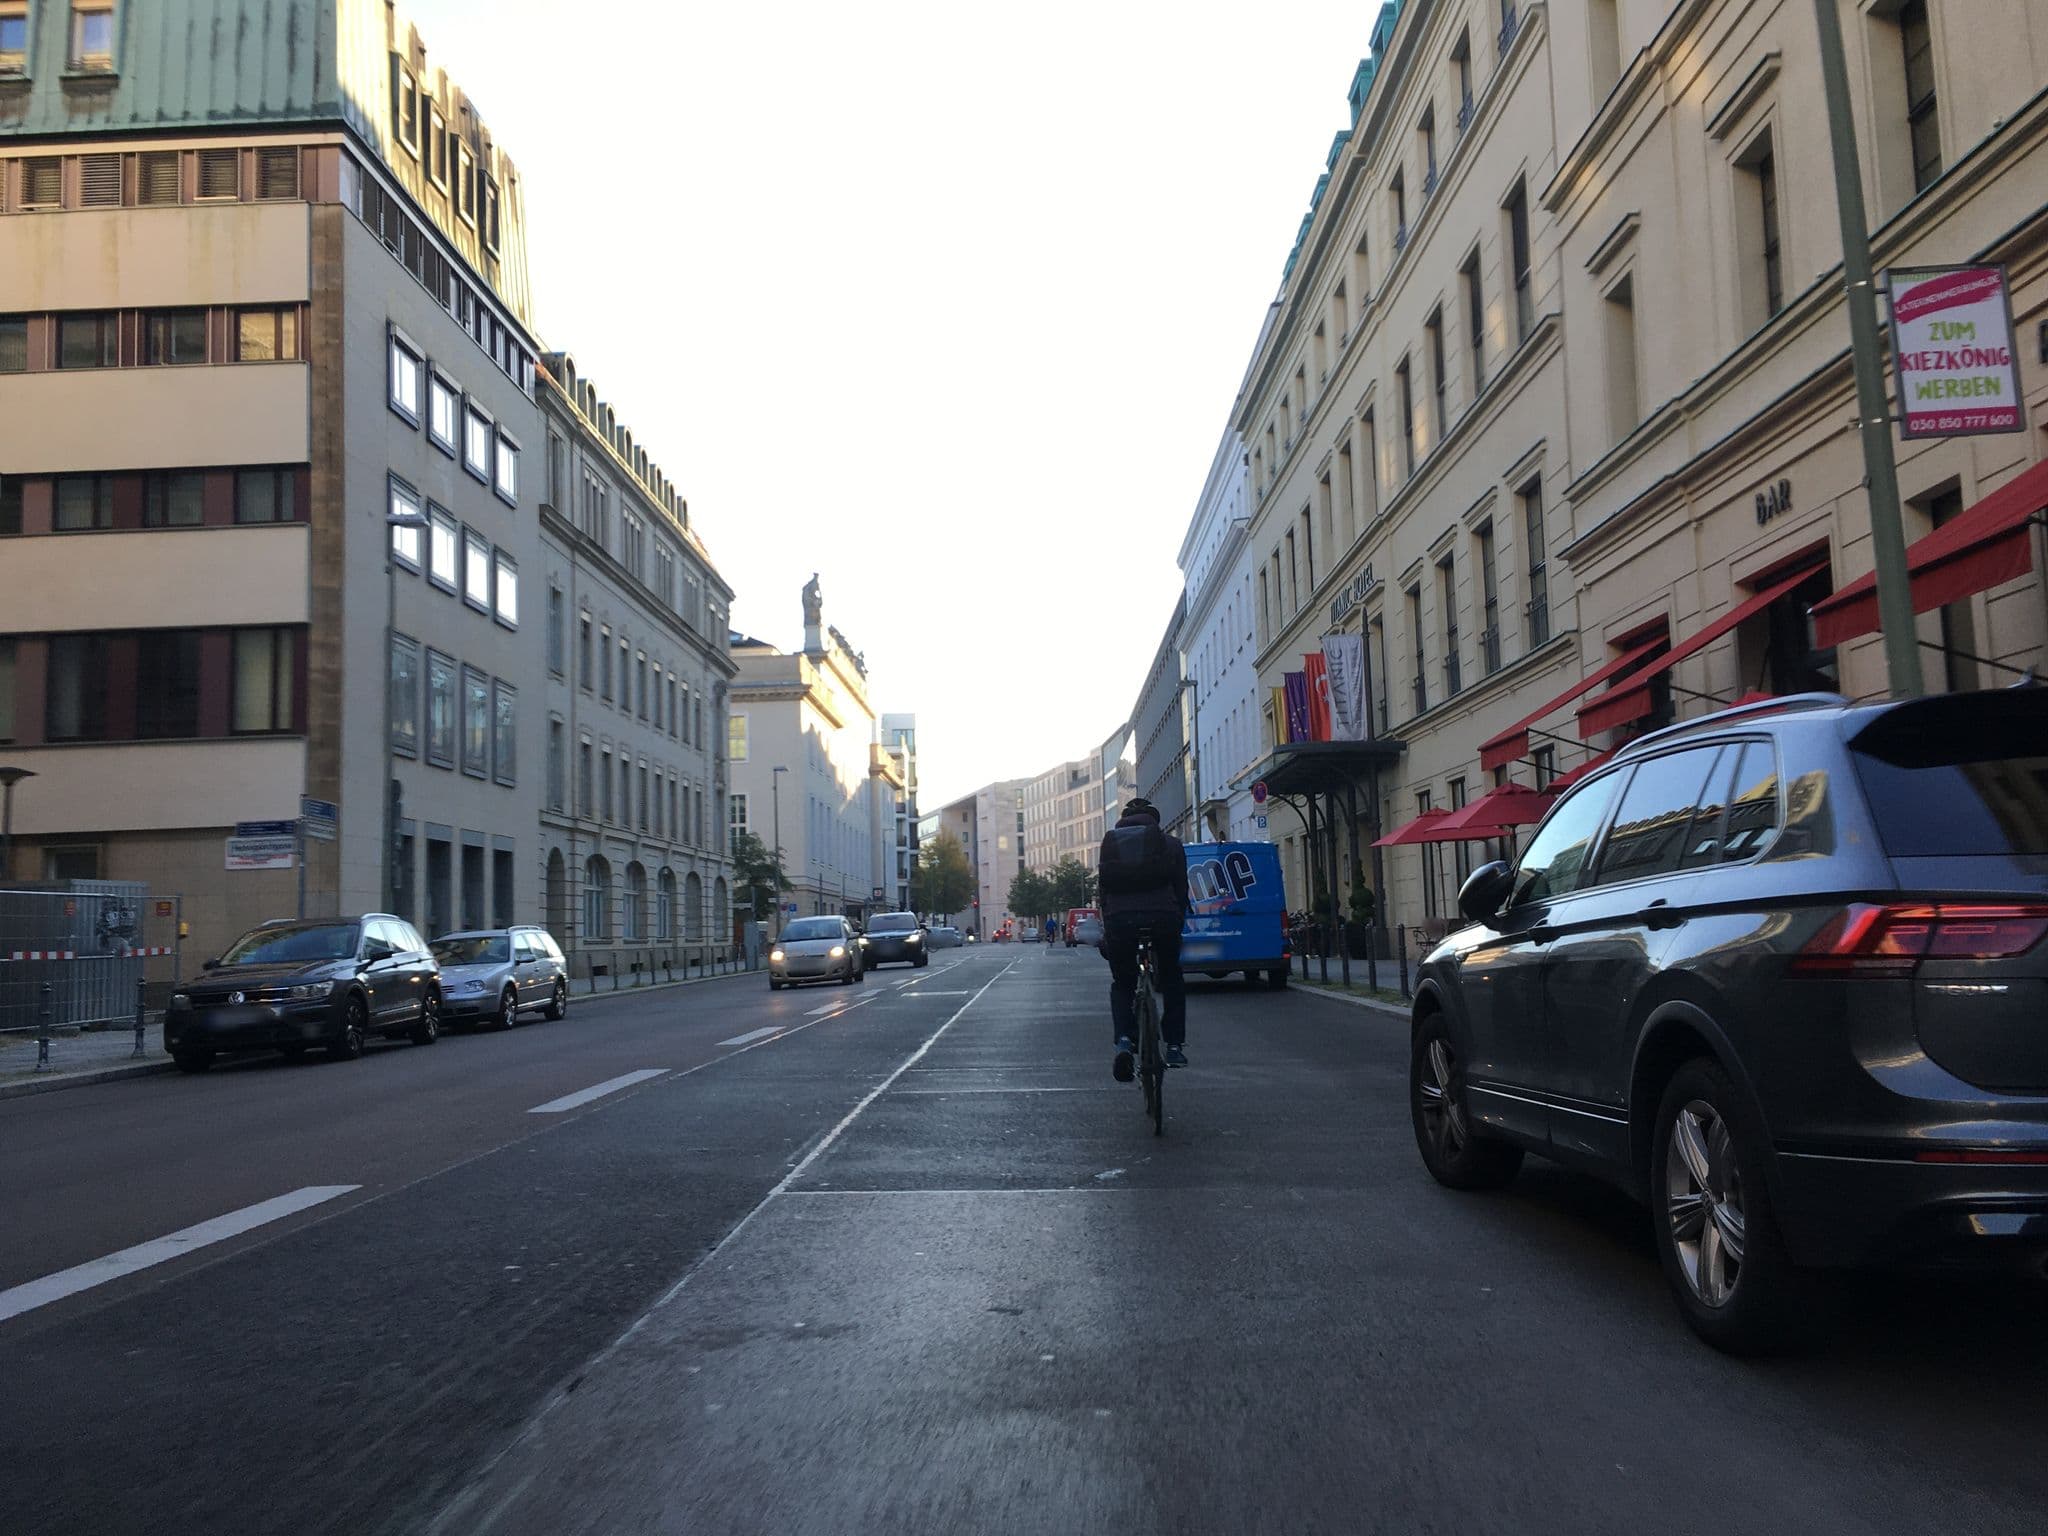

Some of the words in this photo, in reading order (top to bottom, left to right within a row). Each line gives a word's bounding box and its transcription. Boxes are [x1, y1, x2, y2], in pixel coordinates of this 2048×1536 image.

[1928, 321, 1976, 341] ZUM
[1916, 377, 2001, 400] WERBEN
[1755, 478, 1792, 525] BAR
[1329, 648, 1349, 729] TITANIC
